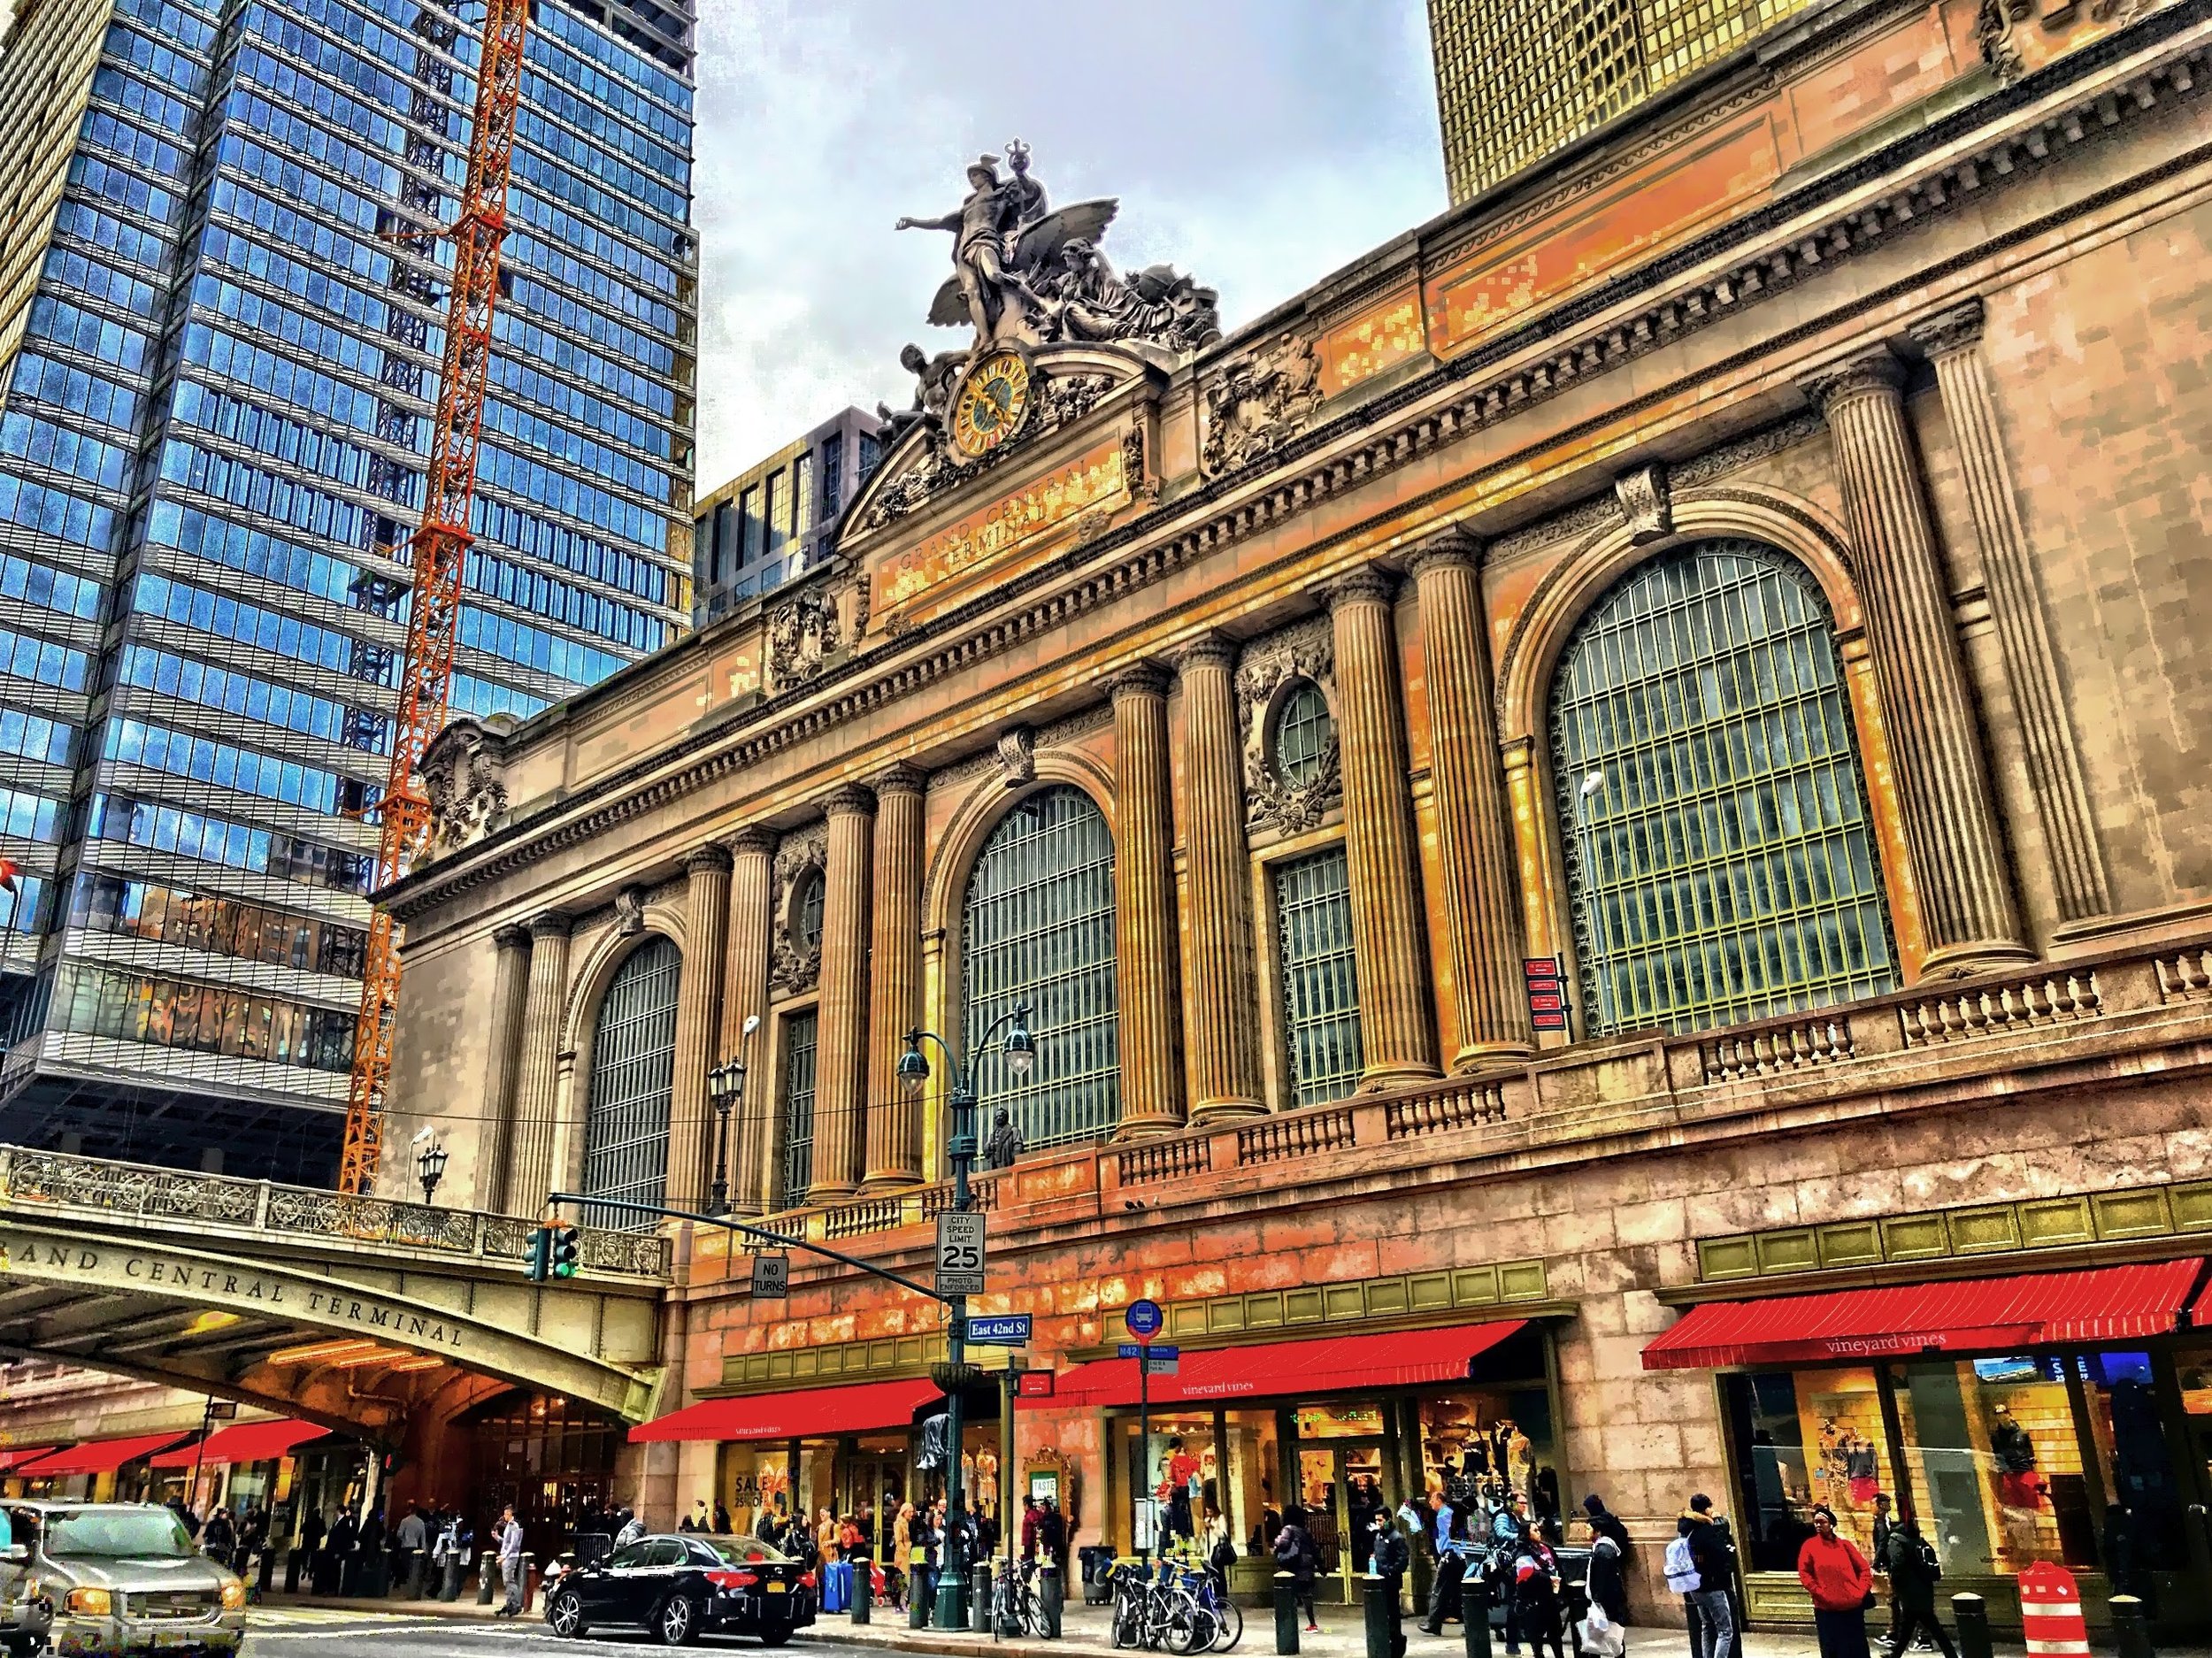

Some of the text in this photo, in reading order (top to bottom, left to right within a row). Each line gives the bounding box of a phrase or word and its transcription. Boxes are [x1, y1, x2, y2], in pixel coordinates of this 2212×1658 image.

[899, 460, 1088, 570] GRAND CENTRAL
[941, 505, 1048, 567] TERMINAL
[946, 1225, 975, 1234] SPEED
[942, 1246, 979, 1269] 25
[763, 1263, 779, 1276] NO
[754, 1279, 786, 1292] TURNS
[125, 1259, 284, 1303] CENTRAL
[309, 1292, 463, 1347] TERMINAL
[972, 1321, 1026, 1336] East 42nd St
[1825, 1332, 1947, 1355] vineyard vines
[735, 1476, 768, 1493] SALE
[1034, 1480, 1055, 1492] TASTE
